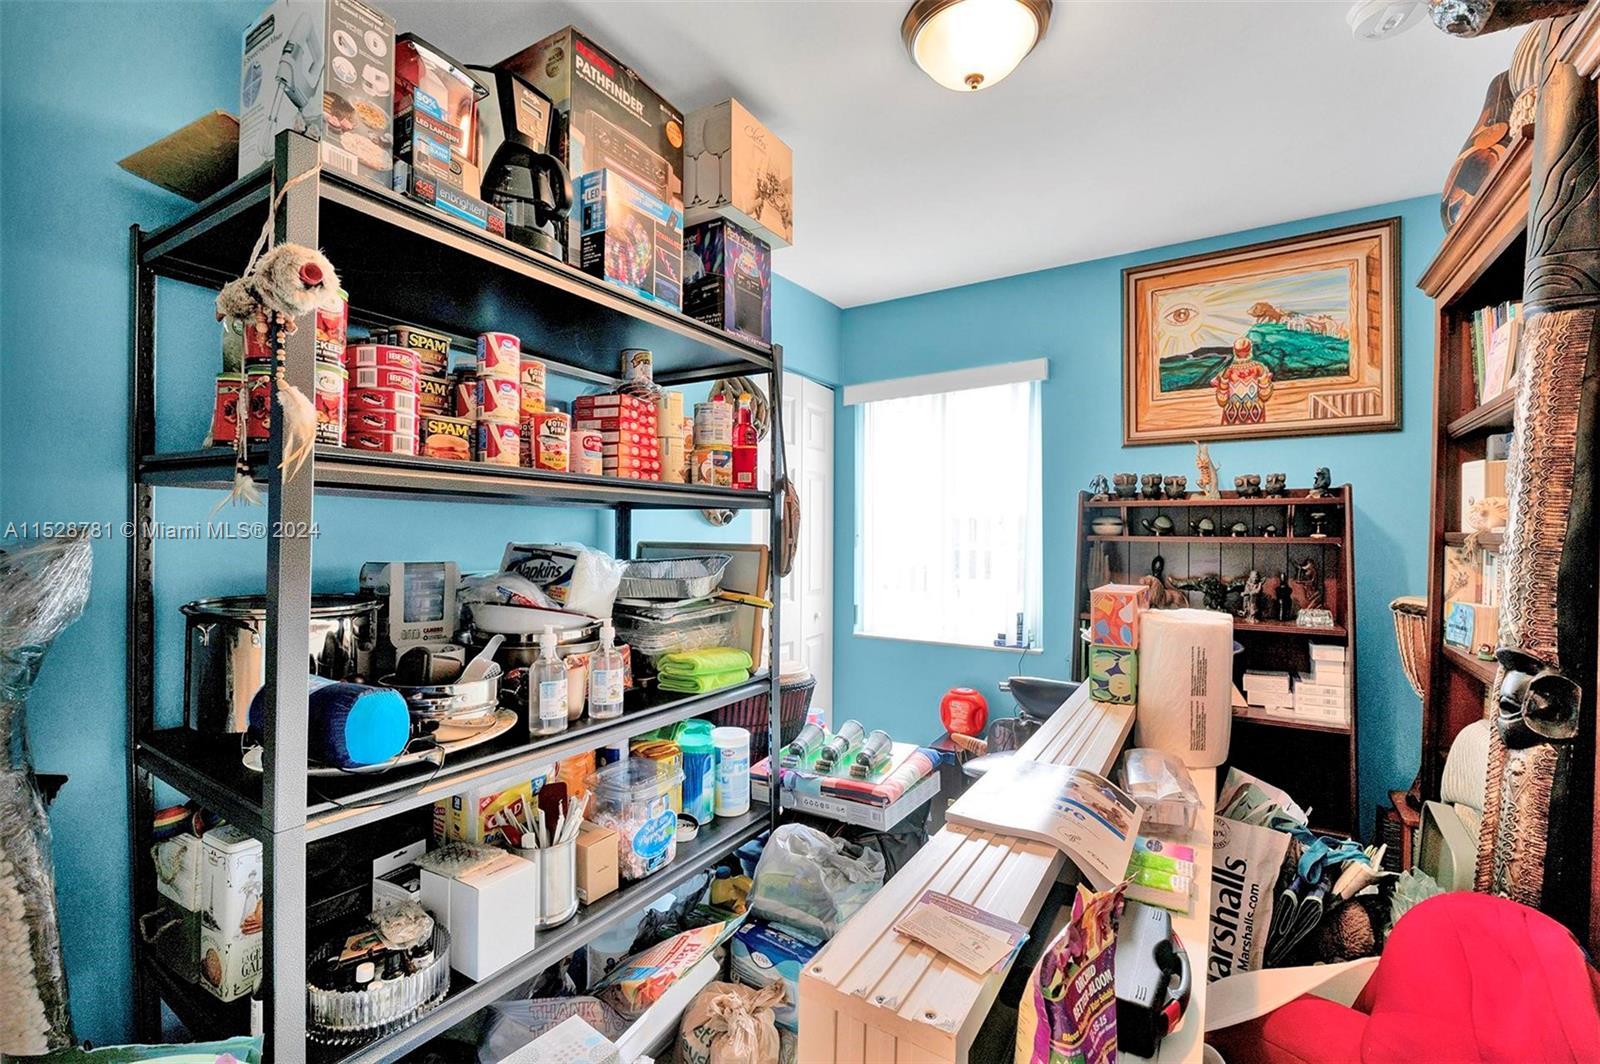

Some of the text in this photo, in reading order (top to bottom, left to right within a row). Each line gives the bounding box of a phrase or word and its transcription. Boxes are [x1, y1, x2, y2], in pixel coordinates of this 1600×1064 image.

[576, 55, 645, 116] PATHFINDER
[415, 116, 460, 143] LED LANTERN
[415, 180, 435, 194] 425
[586, 187, 600, 201] LED
[439, 188, 485, 217] enbrighten
[408, 333, 447, 354] SPAM
[428, 420, 469, 437] SPAM
[517, 562, 563, 581] Napkins
[1237, 884, 1259, 971] Marshalls.com
[529, 1000, 595, 1020] THANK
